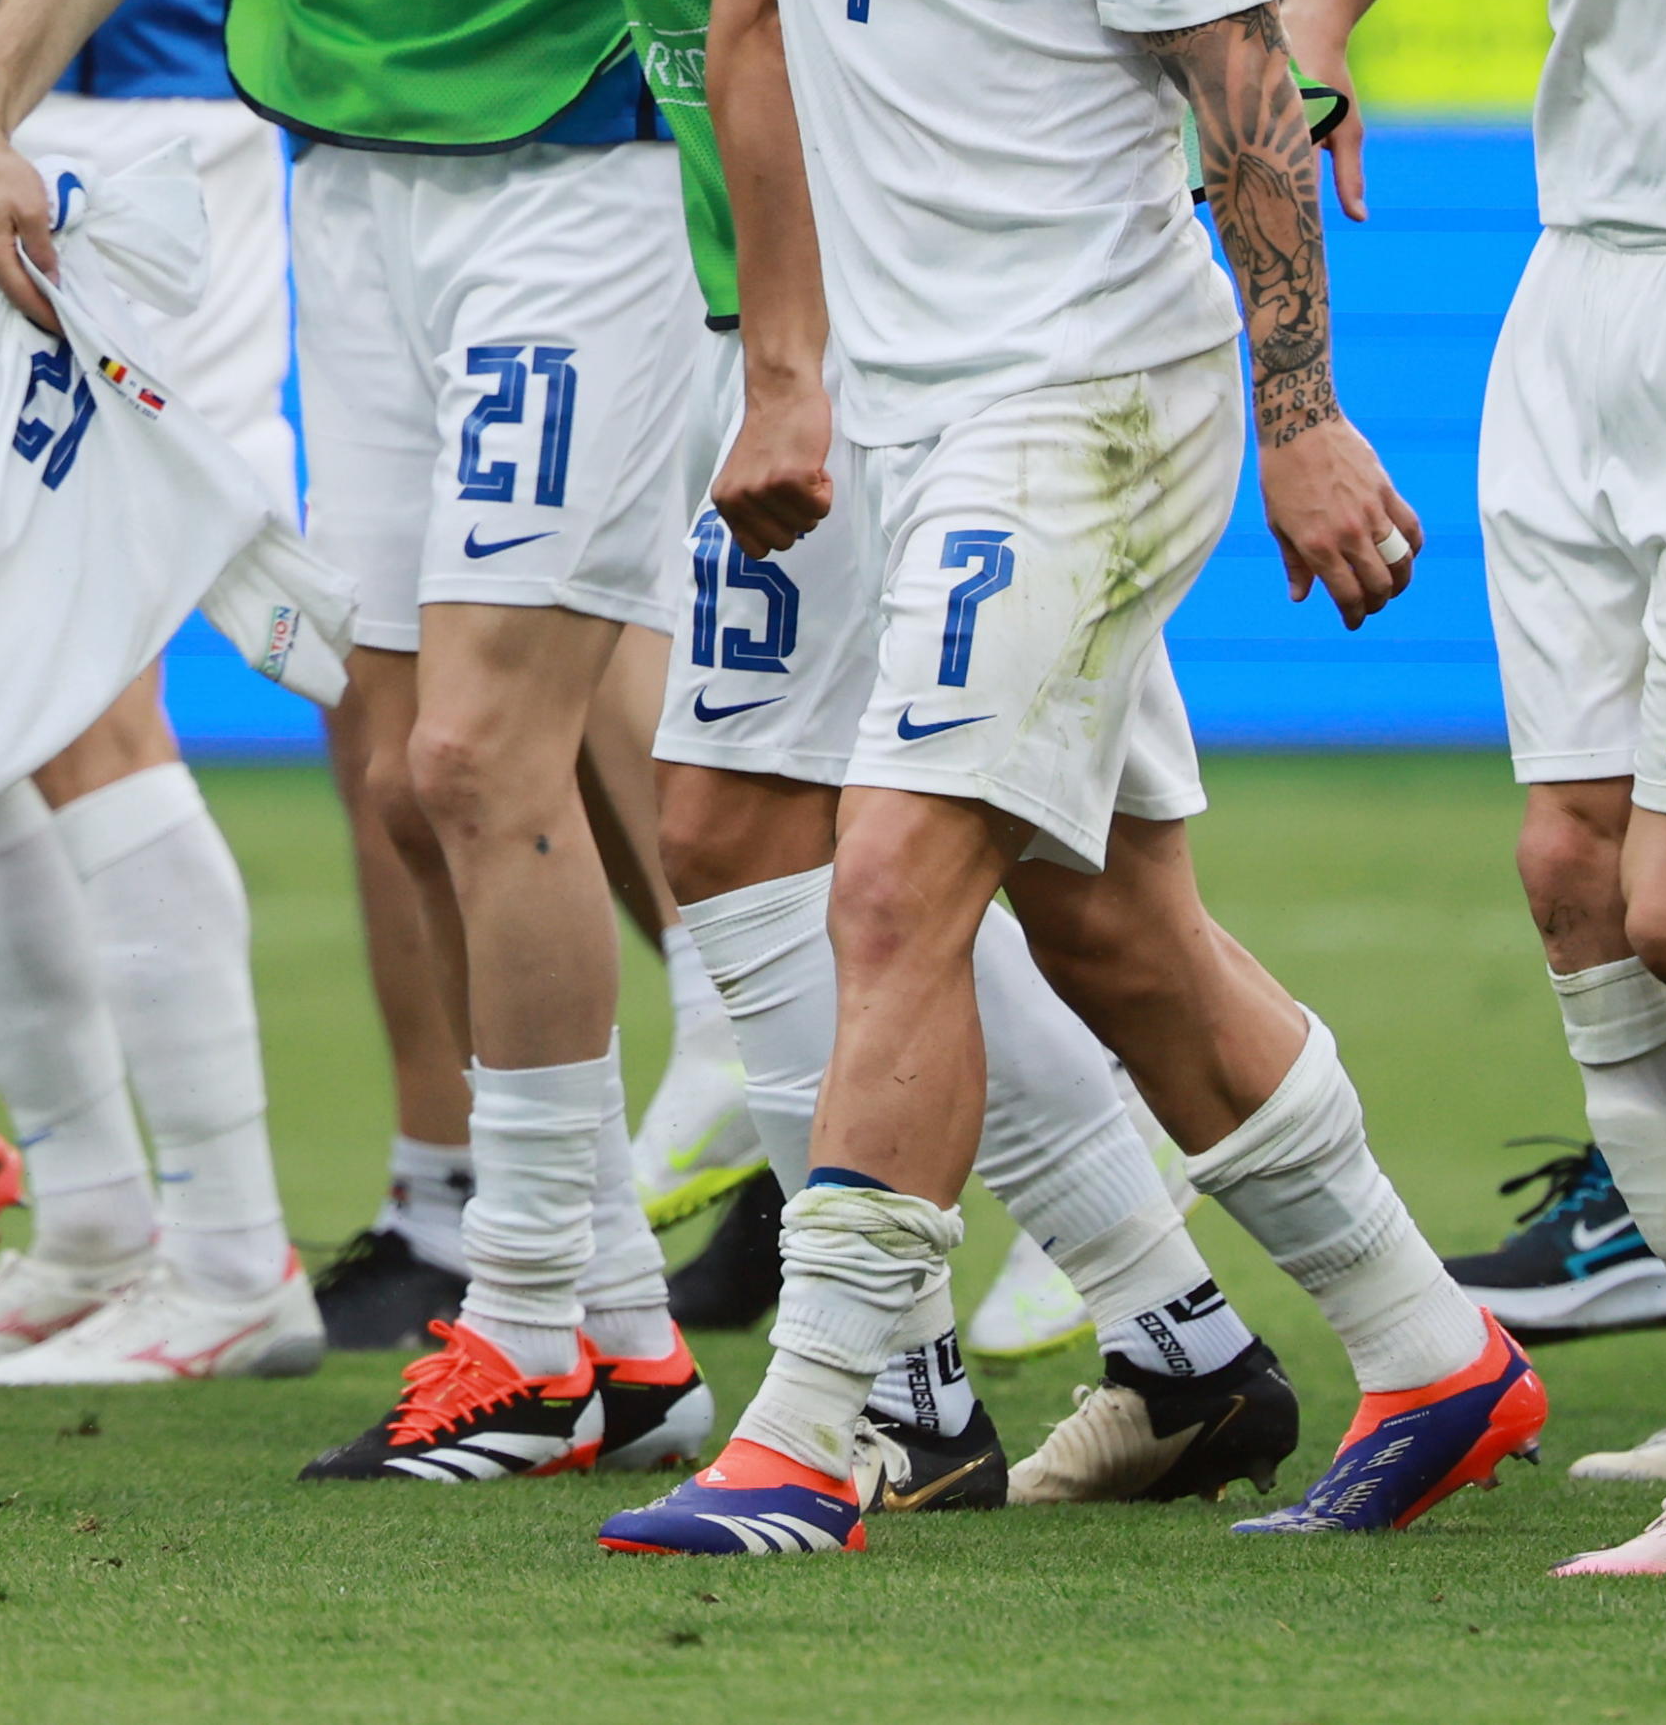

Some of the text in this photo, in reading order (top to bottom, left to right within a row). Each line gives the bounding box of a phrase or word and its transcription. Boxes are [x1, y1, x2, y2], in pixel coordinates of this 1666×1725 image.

[457, 345, 576, 508] 21
[691, 509, 805, 674] 15
[938, 529, 1015, 688] 7
